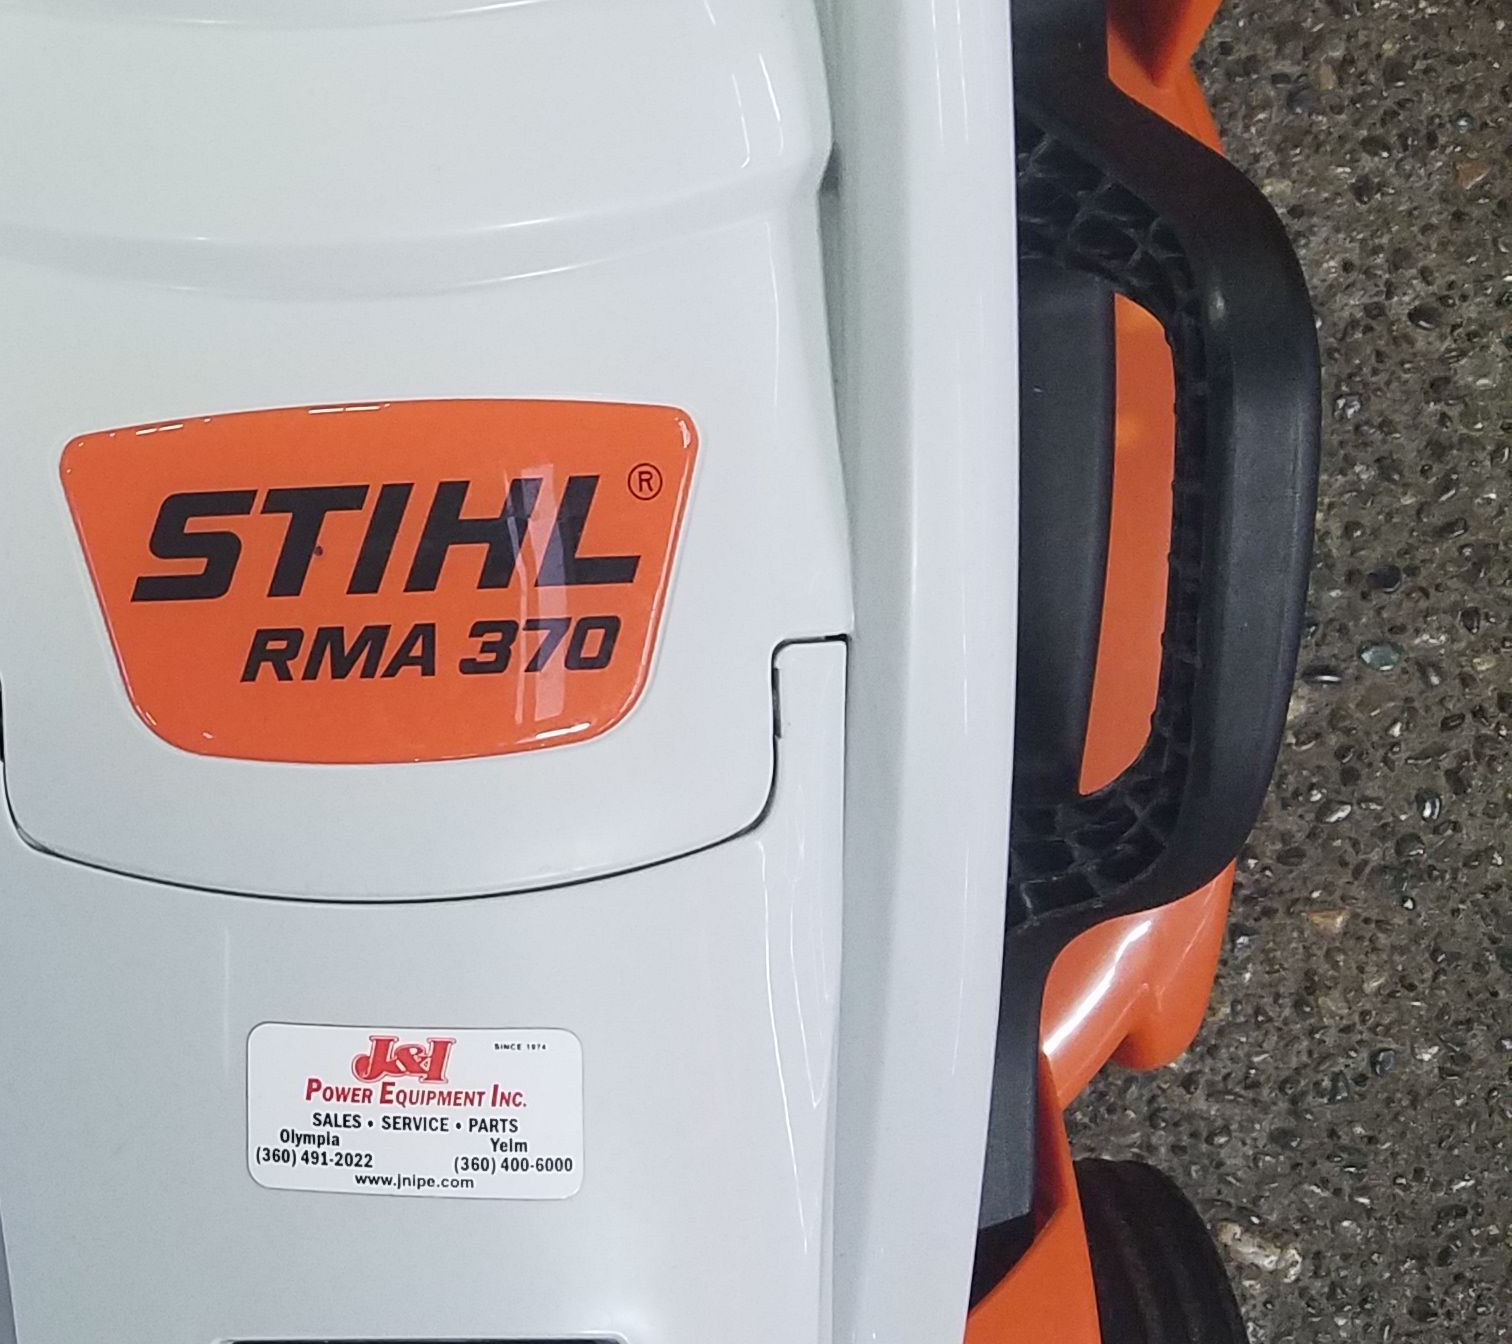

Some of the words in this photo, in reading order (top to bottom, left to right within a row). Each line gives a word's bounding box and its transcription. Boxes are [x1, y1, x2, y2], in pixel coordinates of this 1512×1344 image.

[130, 474, 641, 602] STIHL
[240, 623, 437, 683] RMA
[459, 615, 621, 676] 370
[494, 1042, 522, 1051] SINCE
[305, 1078, 373, 1104] POWER
[379, 1081, 486, 1107] EQUIPMENT
[312, 1112, 362, 1129] SALES
[381, 1116, 449, 1132] SERVICE
[468, 1118, 519, 1133] PARTS
[280, 1129, 340, 1147] Olympia
[490, 1138, 528, 1153] Yelm
[256, 1147, 297, 1167] (360)
[301, 1150, 374, 1168] 491-2022
[454, 1156, 496, 1174] (360)
[500, 1157, 573, 1173] 400-6000
[355, 1174, 475, 1189] www.jnipe.com
